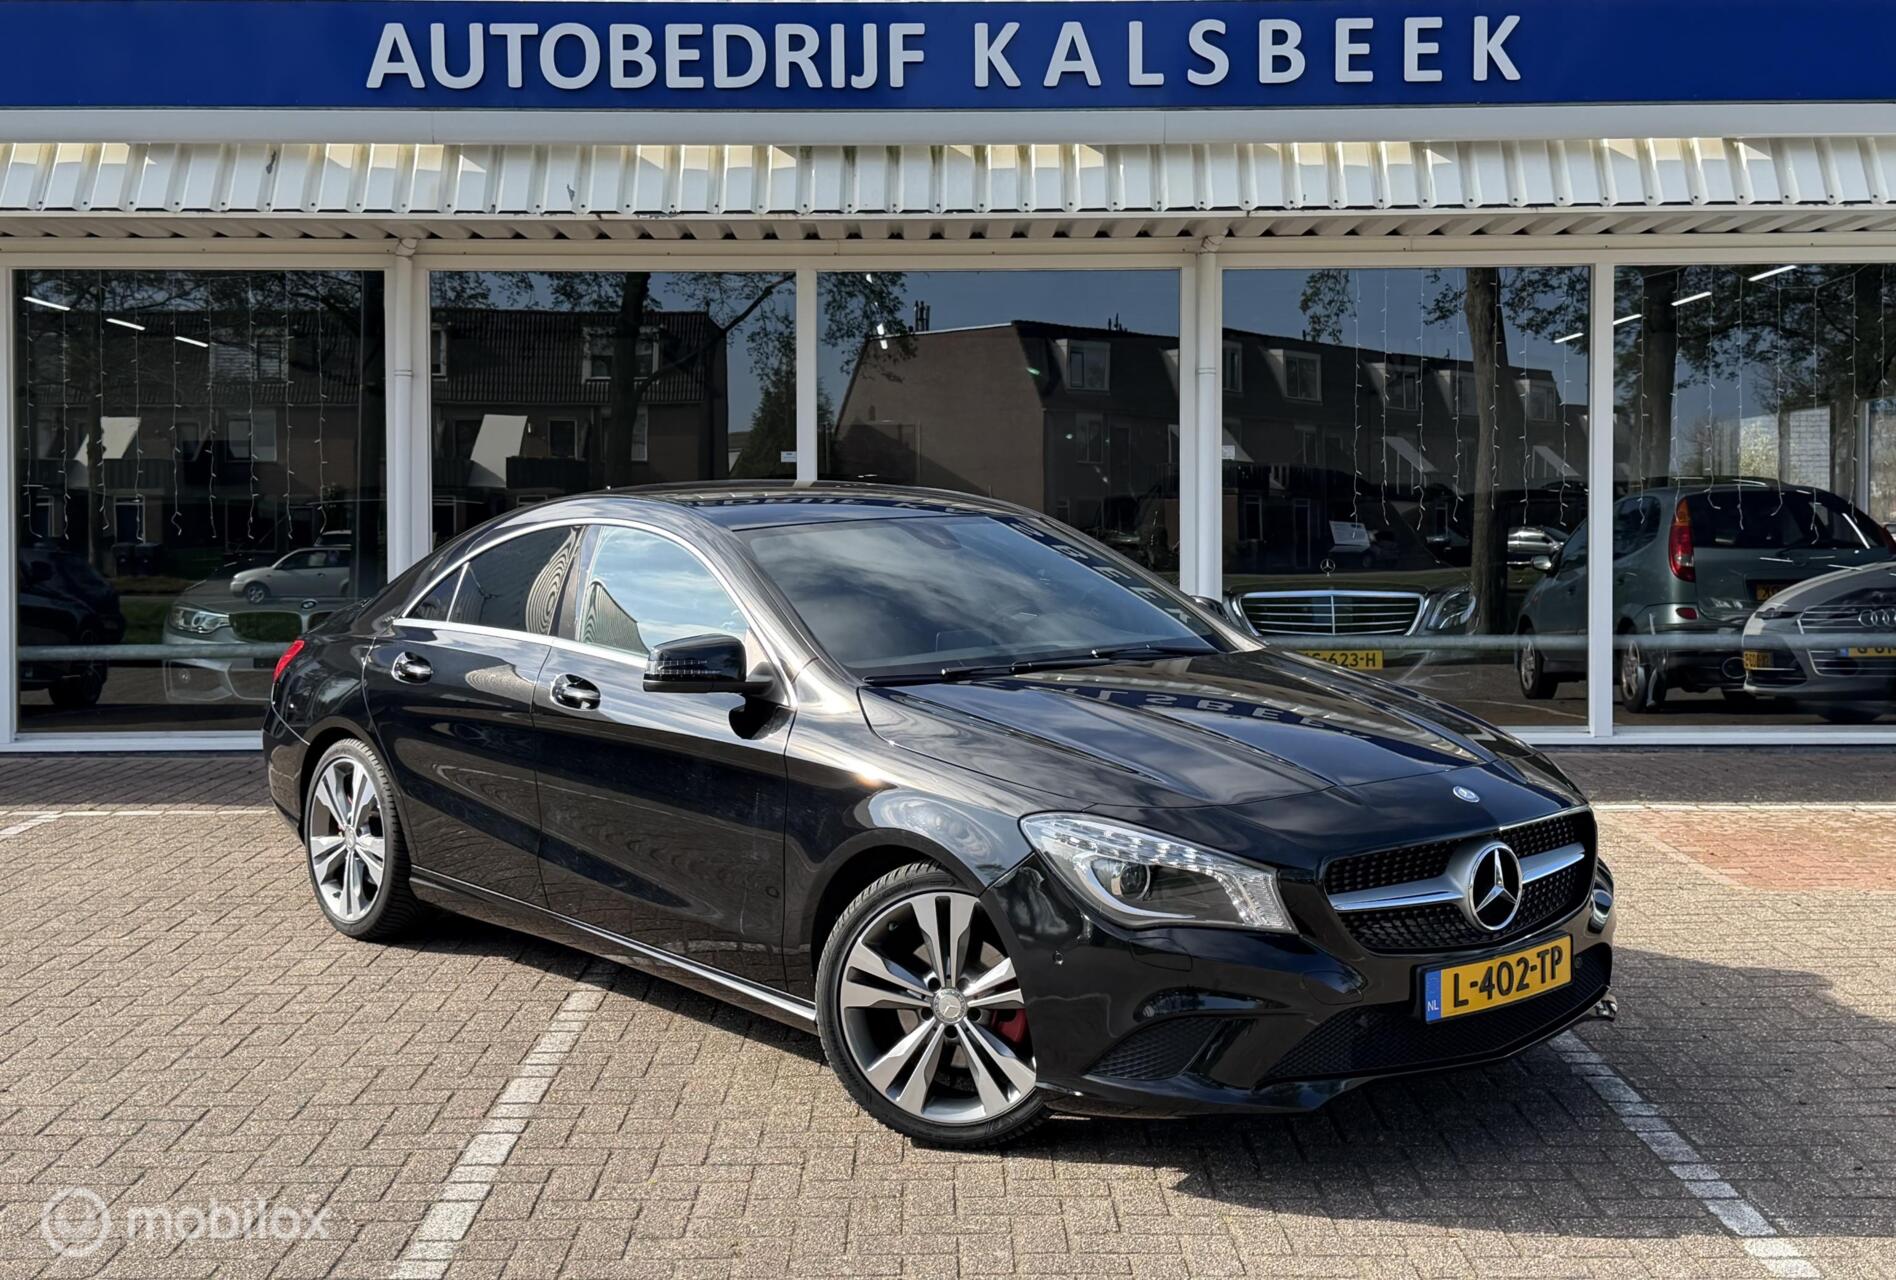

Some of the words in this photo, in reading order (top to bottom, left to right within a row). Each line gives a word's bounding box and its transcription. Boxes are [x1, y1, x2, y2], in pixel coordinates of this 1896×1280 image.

[365, 22, 925, 90] AUTOBEDRIJF
[973, 15, 1522, 88] KALSBEEK
[1427, 1001, 1440, 1012] NL
[1453, 945, 1563, 1008] L-402-TP
